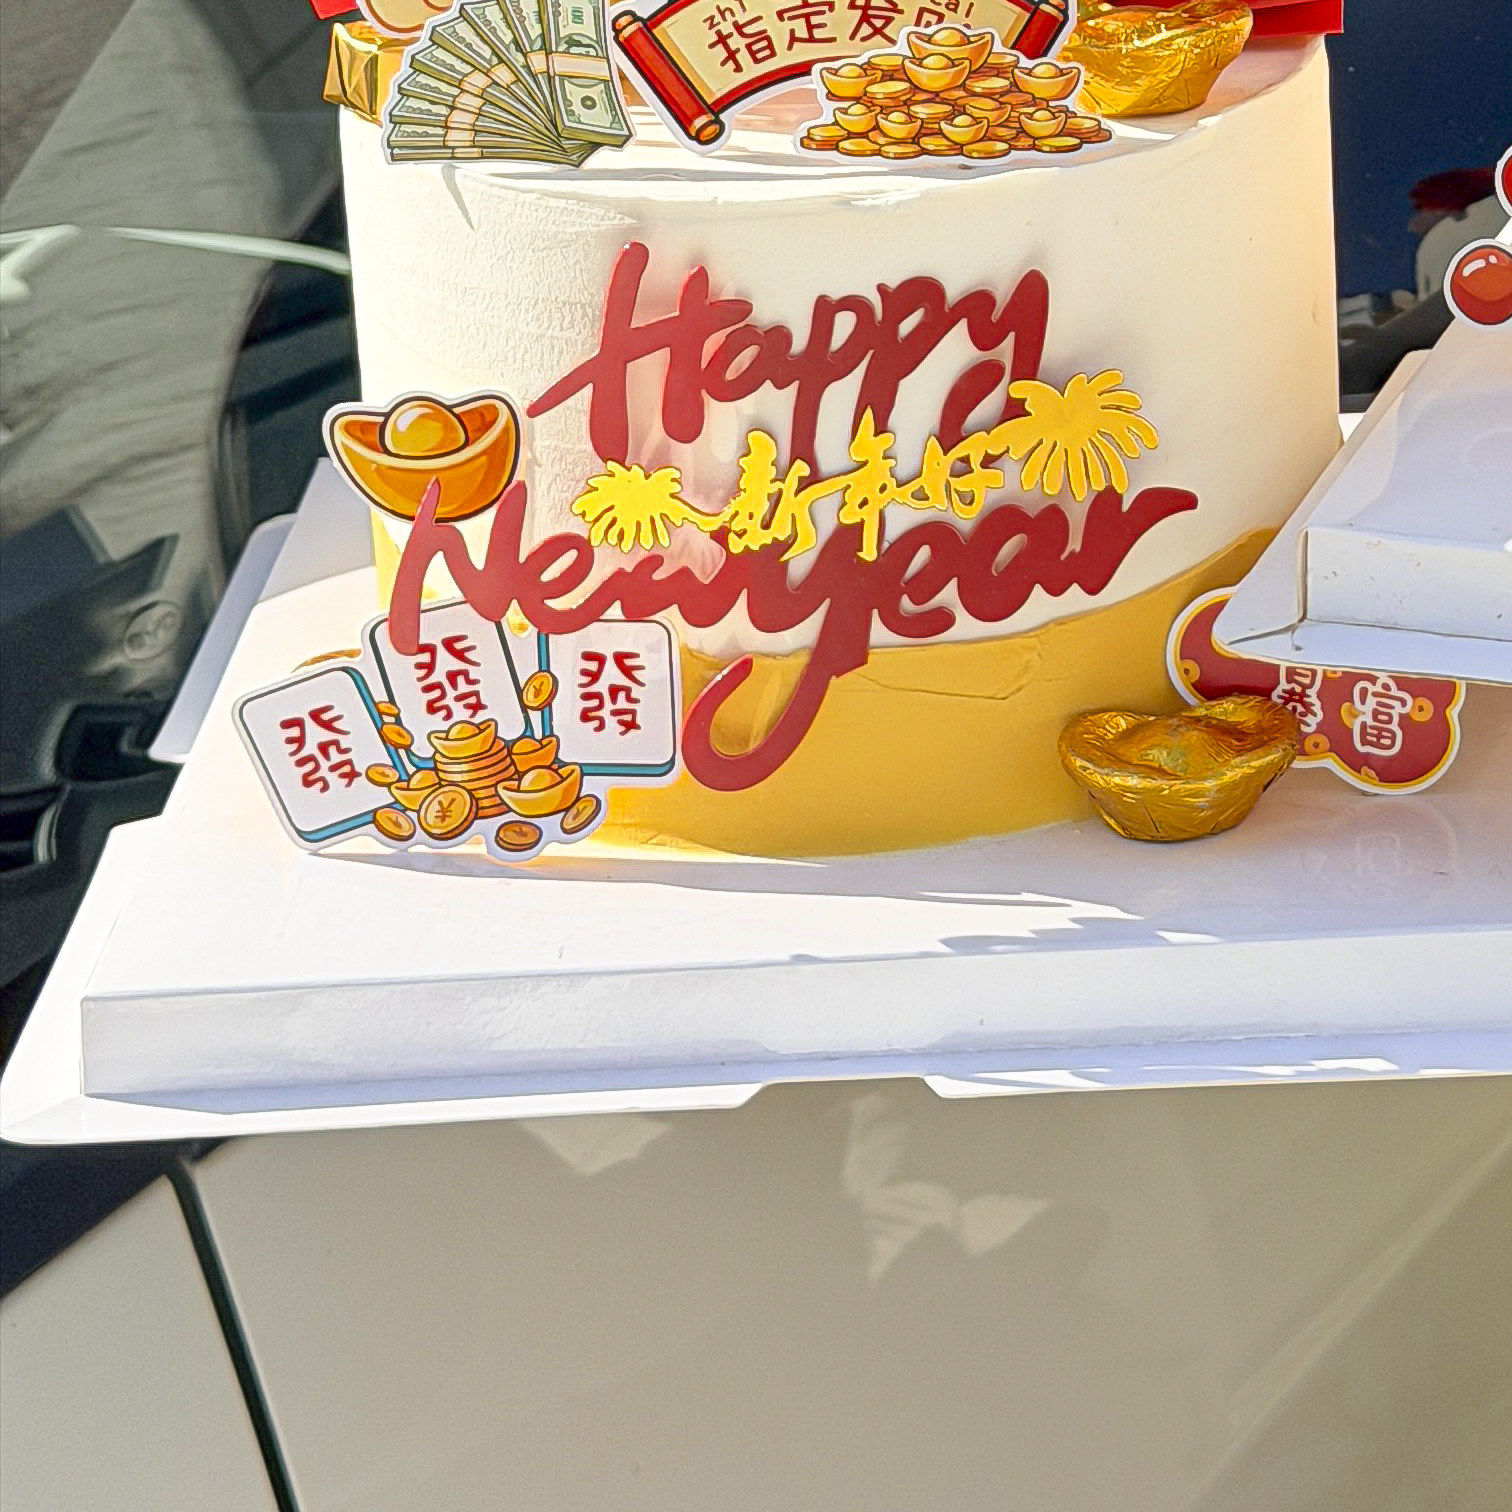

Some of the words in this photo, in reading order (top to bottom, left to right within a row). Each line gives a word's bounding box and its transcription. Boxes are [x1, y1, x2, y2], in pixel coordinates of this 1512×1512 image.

[526, 240, 1050, 482] Happy
[727, 405, 1006, 562] 新年好
